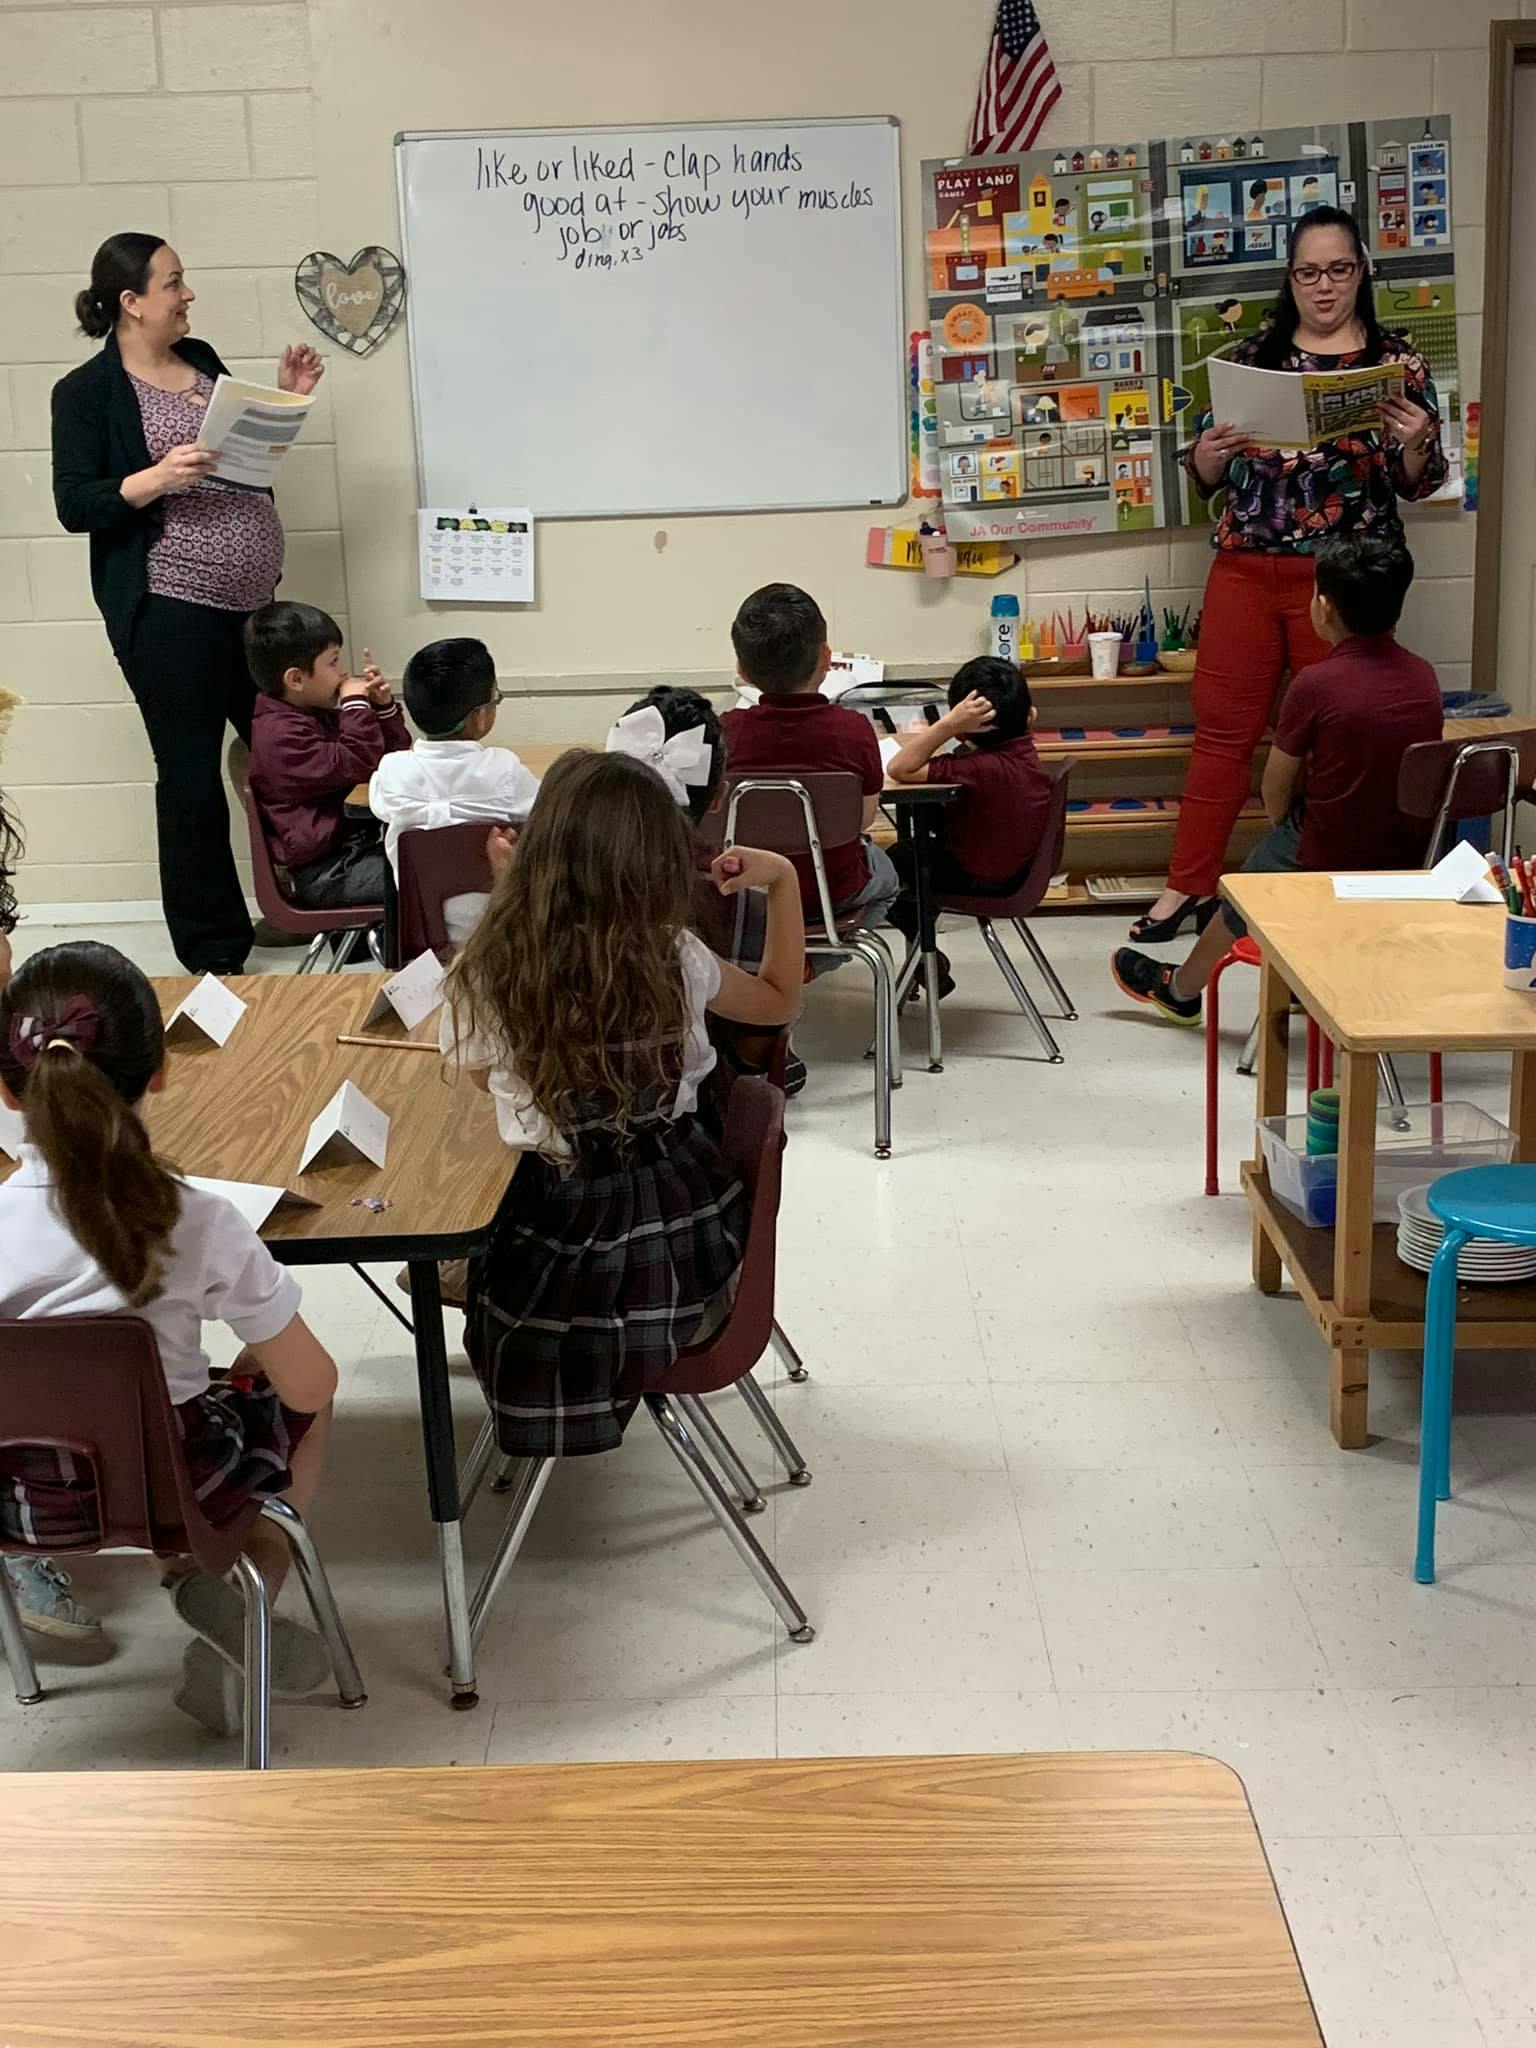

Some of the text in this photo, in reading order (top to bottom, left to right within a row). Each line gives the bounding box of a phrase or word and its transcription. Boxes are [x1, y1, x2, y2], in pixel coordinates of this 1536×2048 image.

[477, 146, 528, 190] like
[537, 159, 564, 181] or
[572, 145, 636, 182] liked
[663, 143, 721, 191] clap
[733, 143, 803, 174] hands
[937, 173, 1015, 191] PLAY LAND
[523, 191, 585, 234] good
[595, 185, 628, 215] at
[652, 184, 721, 218] show
[732, 186, 791, 220] your
[798, 181, 874, 210] muscles
[556, 216, 602, 261] job
[618, 219, 644, 241] or
[969, 517, 1095, 537] JA Our Community
